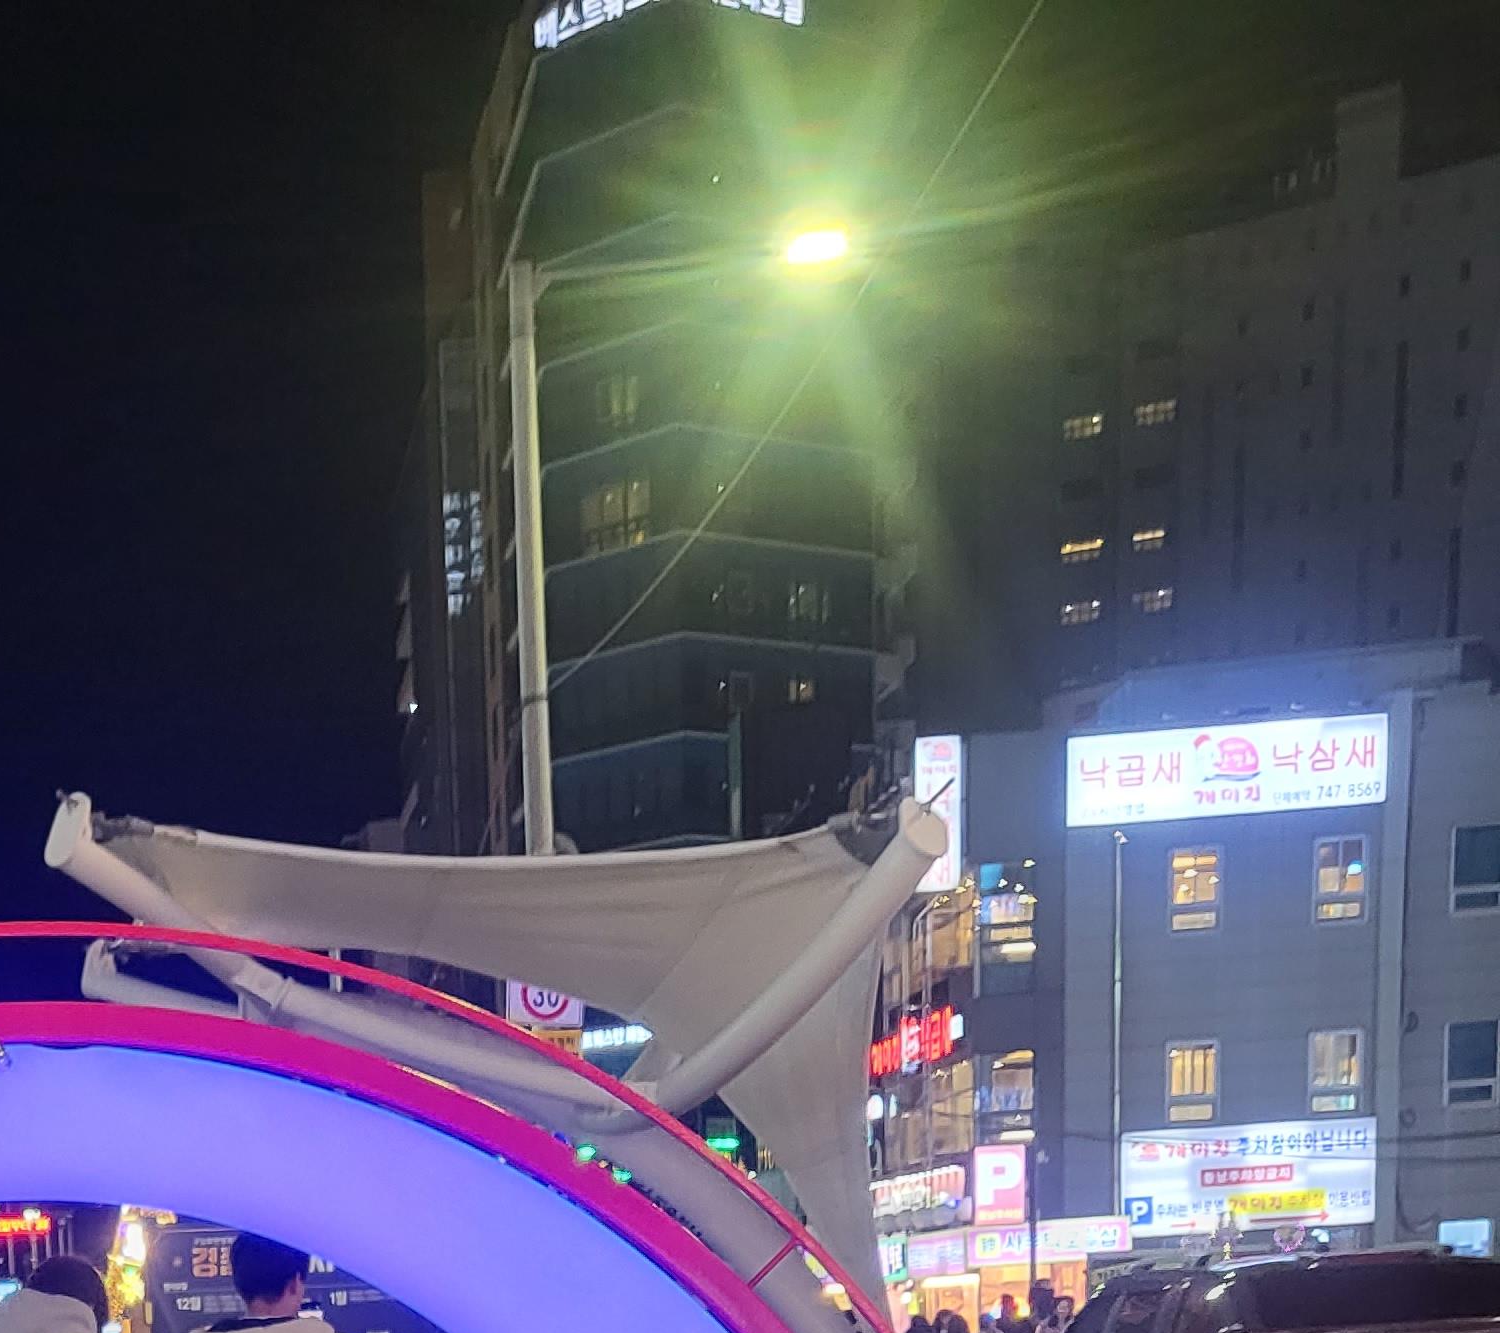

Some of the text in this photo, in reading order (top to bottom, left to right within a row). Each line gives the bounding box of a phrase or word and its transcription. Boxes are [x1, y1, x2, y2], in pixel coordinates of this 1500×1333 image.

[1079, 735, 1377, 788] 낙곱새 낙삼새
[1194, 784, 1261, 805] 개미집
[979, 1151, 1023, 1206] P
